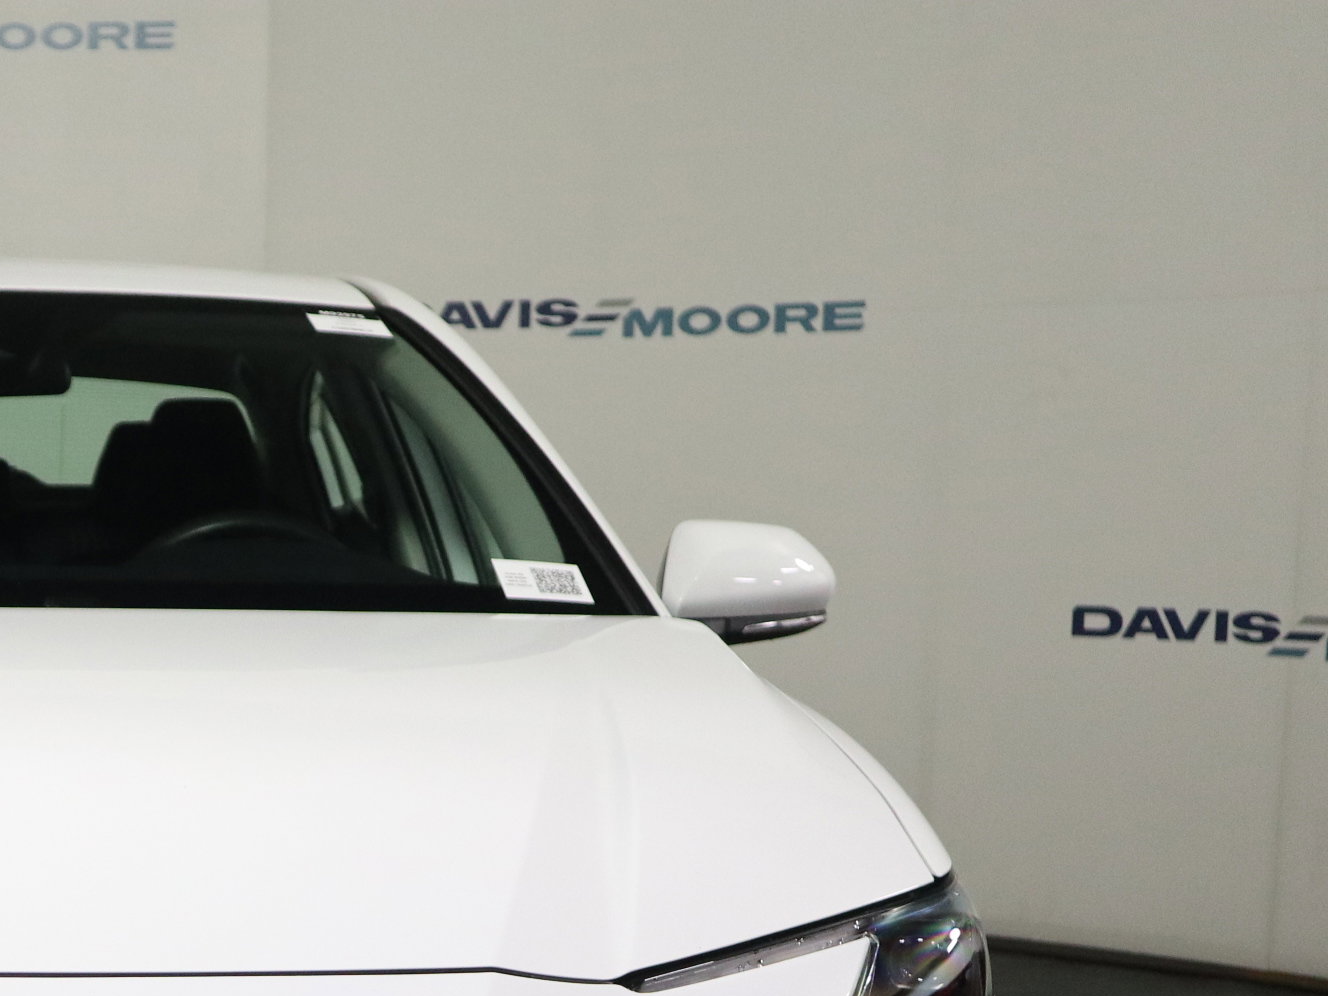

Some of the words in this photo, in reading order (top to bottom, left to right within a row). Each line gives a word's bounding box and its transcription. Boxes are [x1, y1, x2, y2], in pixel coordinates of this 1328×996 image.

[438, 297, 580, 331] AVIS
[621, 299, 867, 340] MOORE
[1070, 604, 1283, 647] DAVIS
